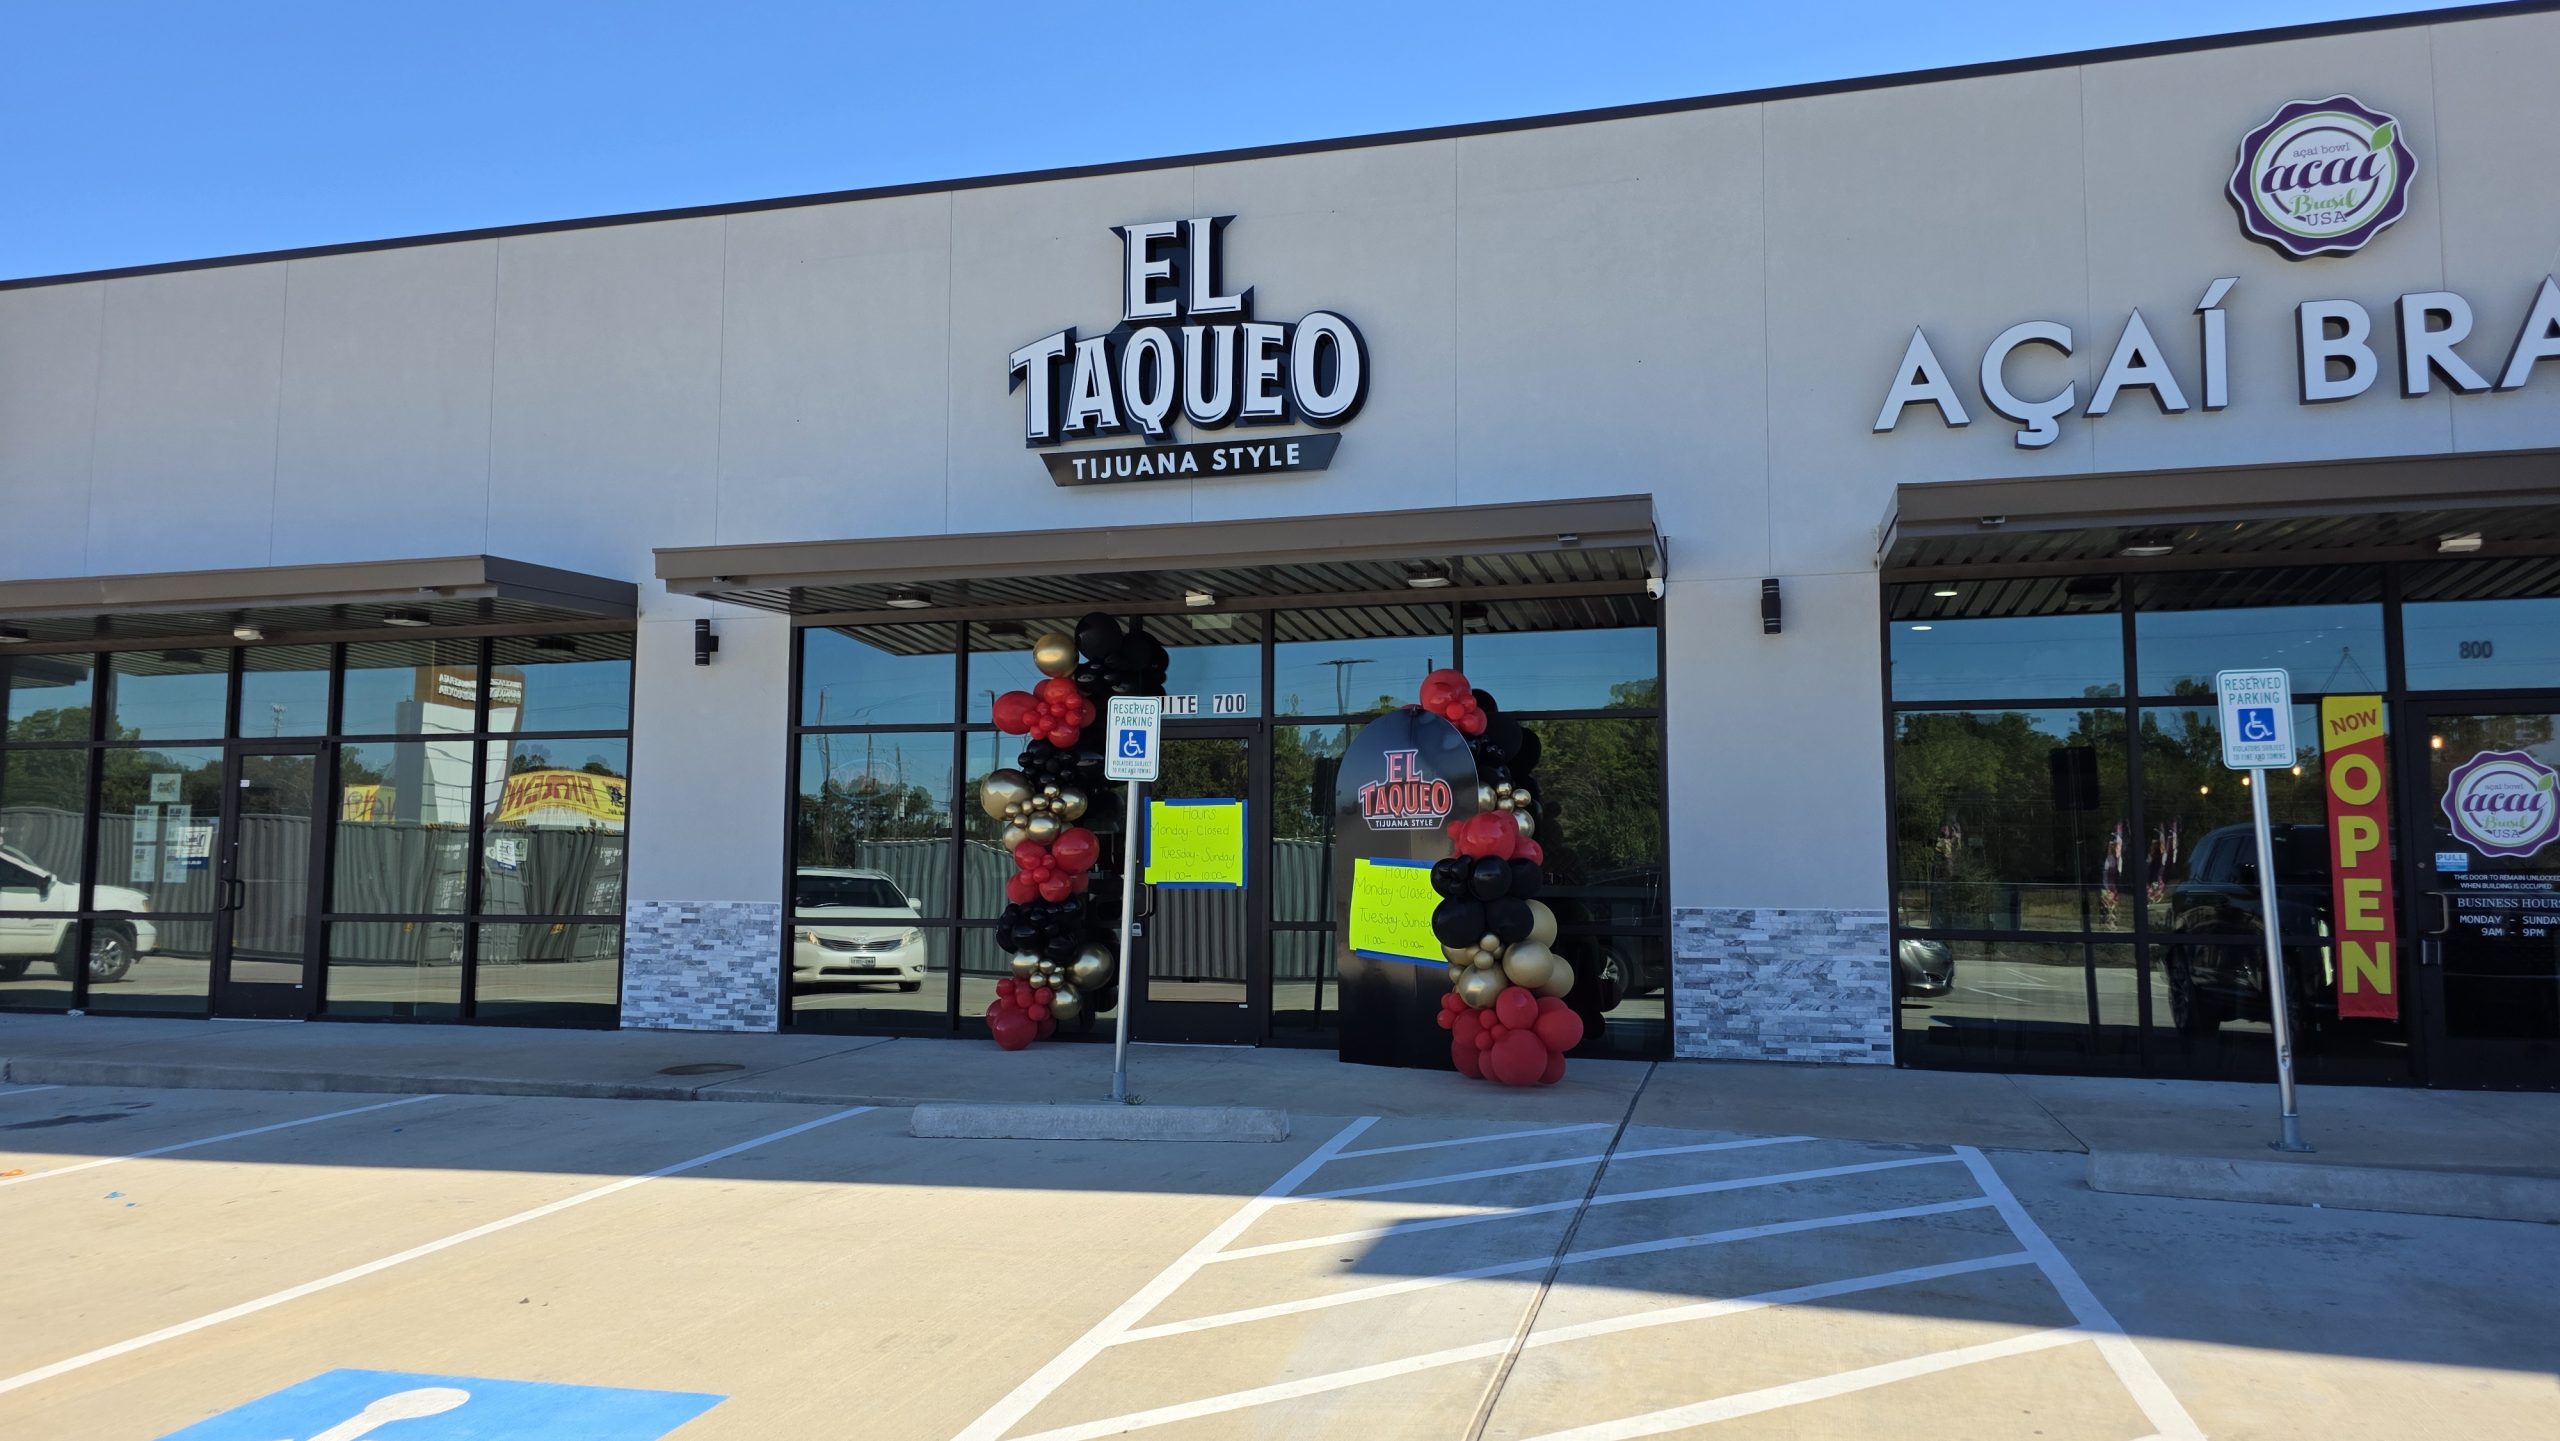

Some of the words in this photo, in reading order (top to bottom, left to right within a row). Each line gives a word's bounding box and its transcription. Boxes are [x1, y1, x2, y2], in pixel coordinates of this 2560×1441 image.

[2321, 142, 2350, 154] bowl
[2290, 188, 2357, 215] Brasil
[2306, 211, 2347, 226] USA
[1120, 215, 1250, 323] EL
[1872, 276, 2241, 449] AÇAÍ
[1009, 310, 1366, 444] TAQUEO
[1072, 451, 1199, 480] TIJUANA
[1211, 442, 1300, 470] STYLE
[2459, 640, 2493, 659] 800
[2224, 677, 2281, 691] RESERVED
[1158, 696, 1197, 713] UITE
[1214, 694, 1245, 713] 700
[2228, 692, 2280, 705] PARKING
[1113, 704, 1156, 715] RESERVED
[1115, 716, 1153, 727] PARKING
[2330, 709, 2377, 735] NOW
[1388, 753, 1420, 782] EL
[1361, 781, 1450, 816] TAQUEO
[1183, 807, 1217, 820] Hours
[2483, 815, 2527, 828] Brasil
[1197, 824, 1230, 836] Closed
[2493, 829, 2520, 838] USA
[1201, 848, 1235, 869] Sunday
[1385, 867, 1420, 880] Hours
[2329, 753, 2392, 995] OPEN
[1400, 885, 1433, 900] Closed
[2457, 898, 2518, 908] BUSINESS
[2460, 915, 2502, 924] MONDAY
[2481, 927, 2503, 936] 9AM
[2522, 928, 2545, 937] 9PM
